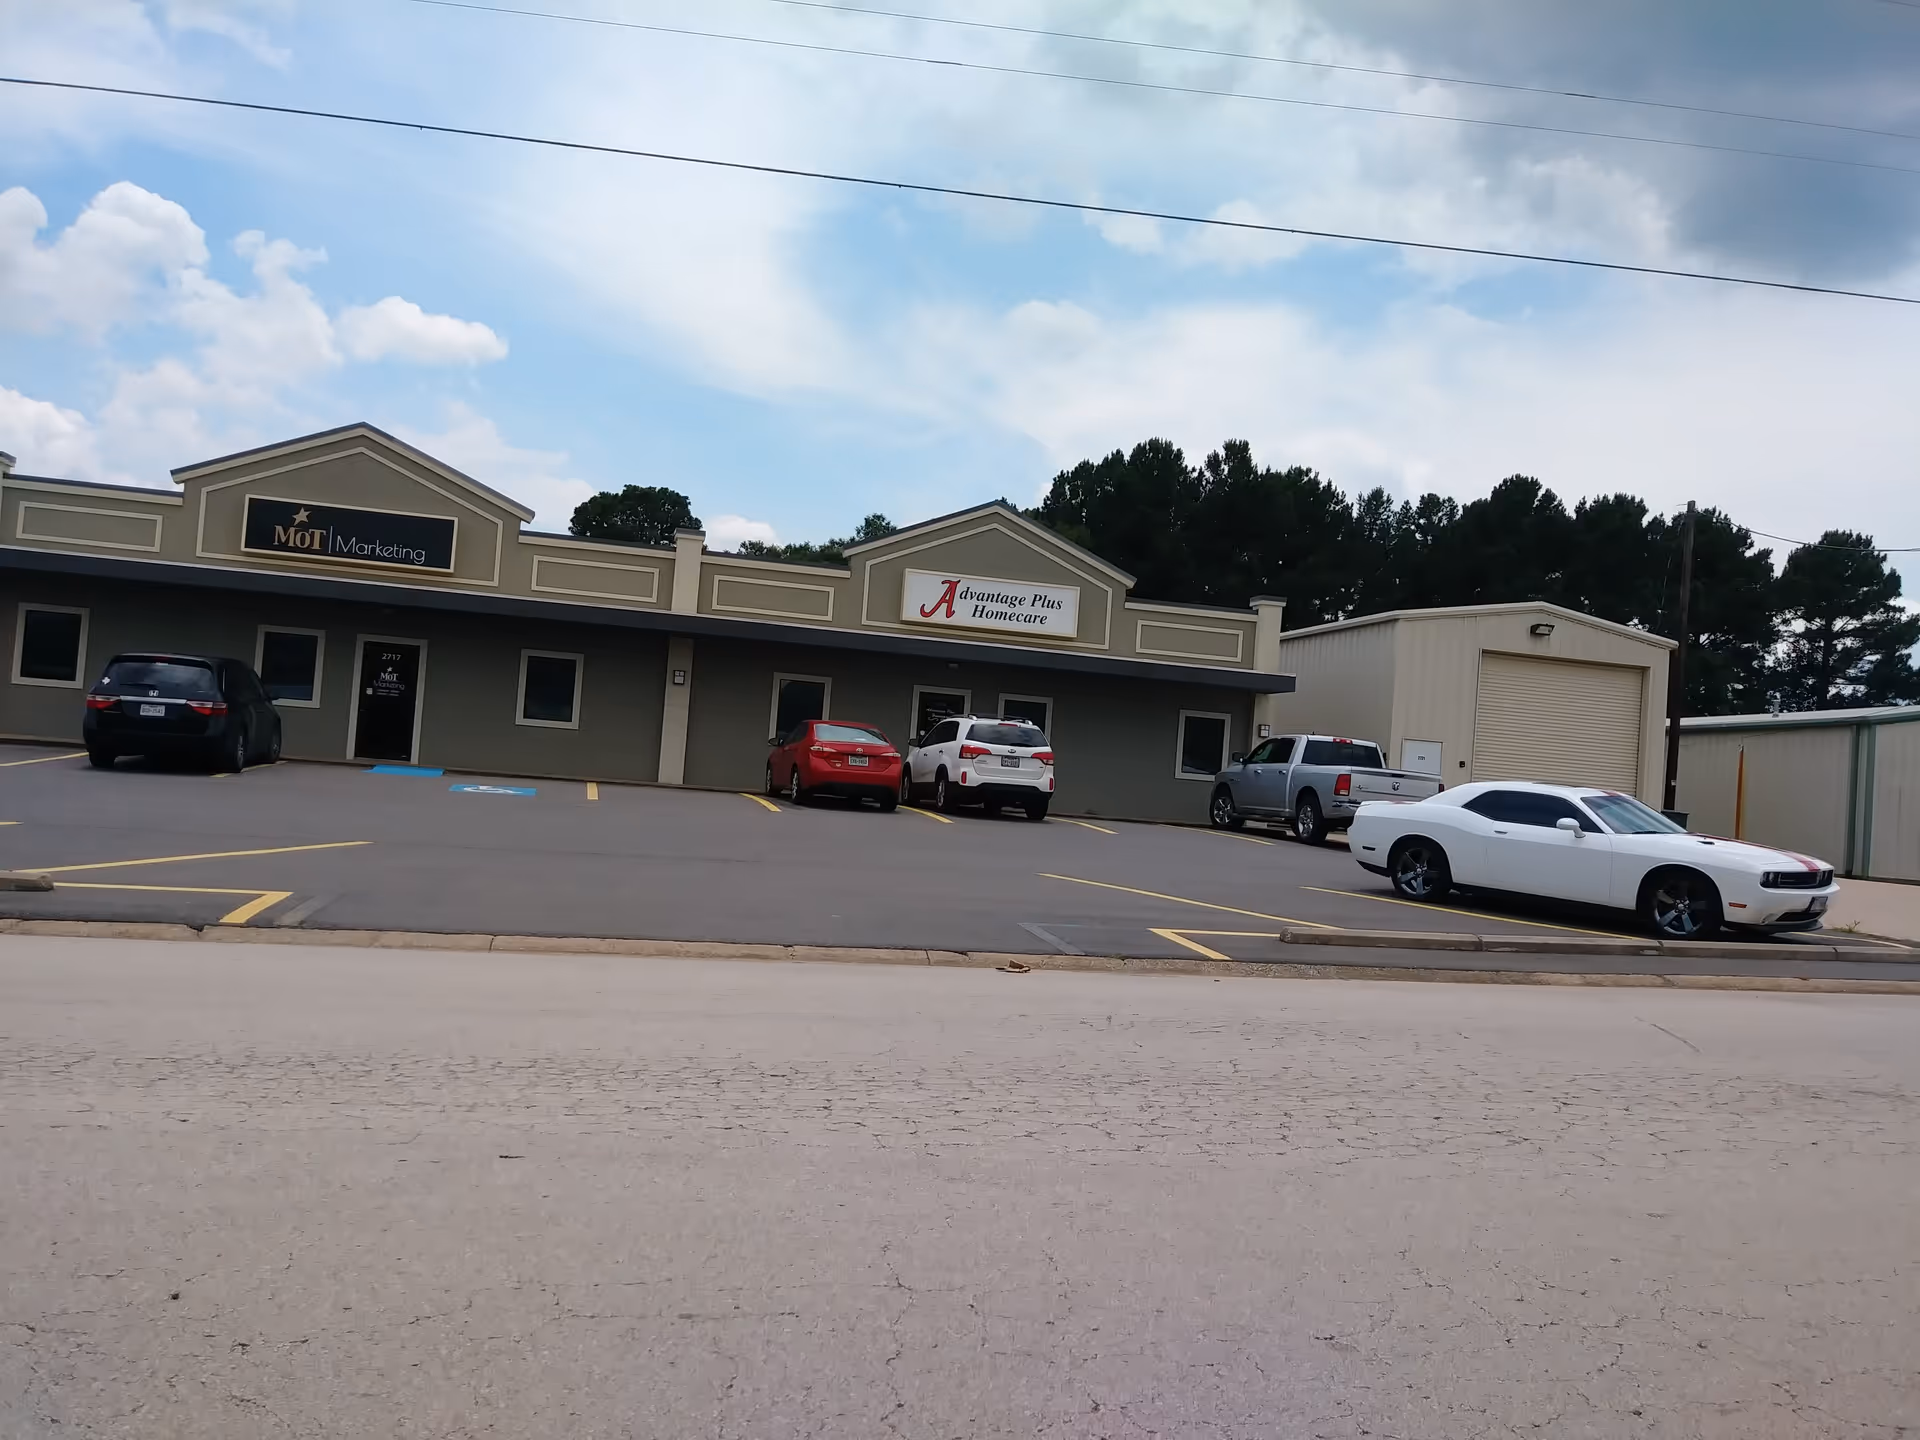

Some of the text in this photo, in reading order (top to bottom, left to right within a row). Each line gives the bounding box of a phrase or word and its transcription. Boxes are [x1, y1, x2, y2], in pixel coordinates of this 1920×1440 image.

[336, 535, 426, 564] Marketing
[919, 579, 1064, 619] Advantage Plus
[971, 604, 1048, 625] Homecare
[381, 653, 402, 661] 2717
